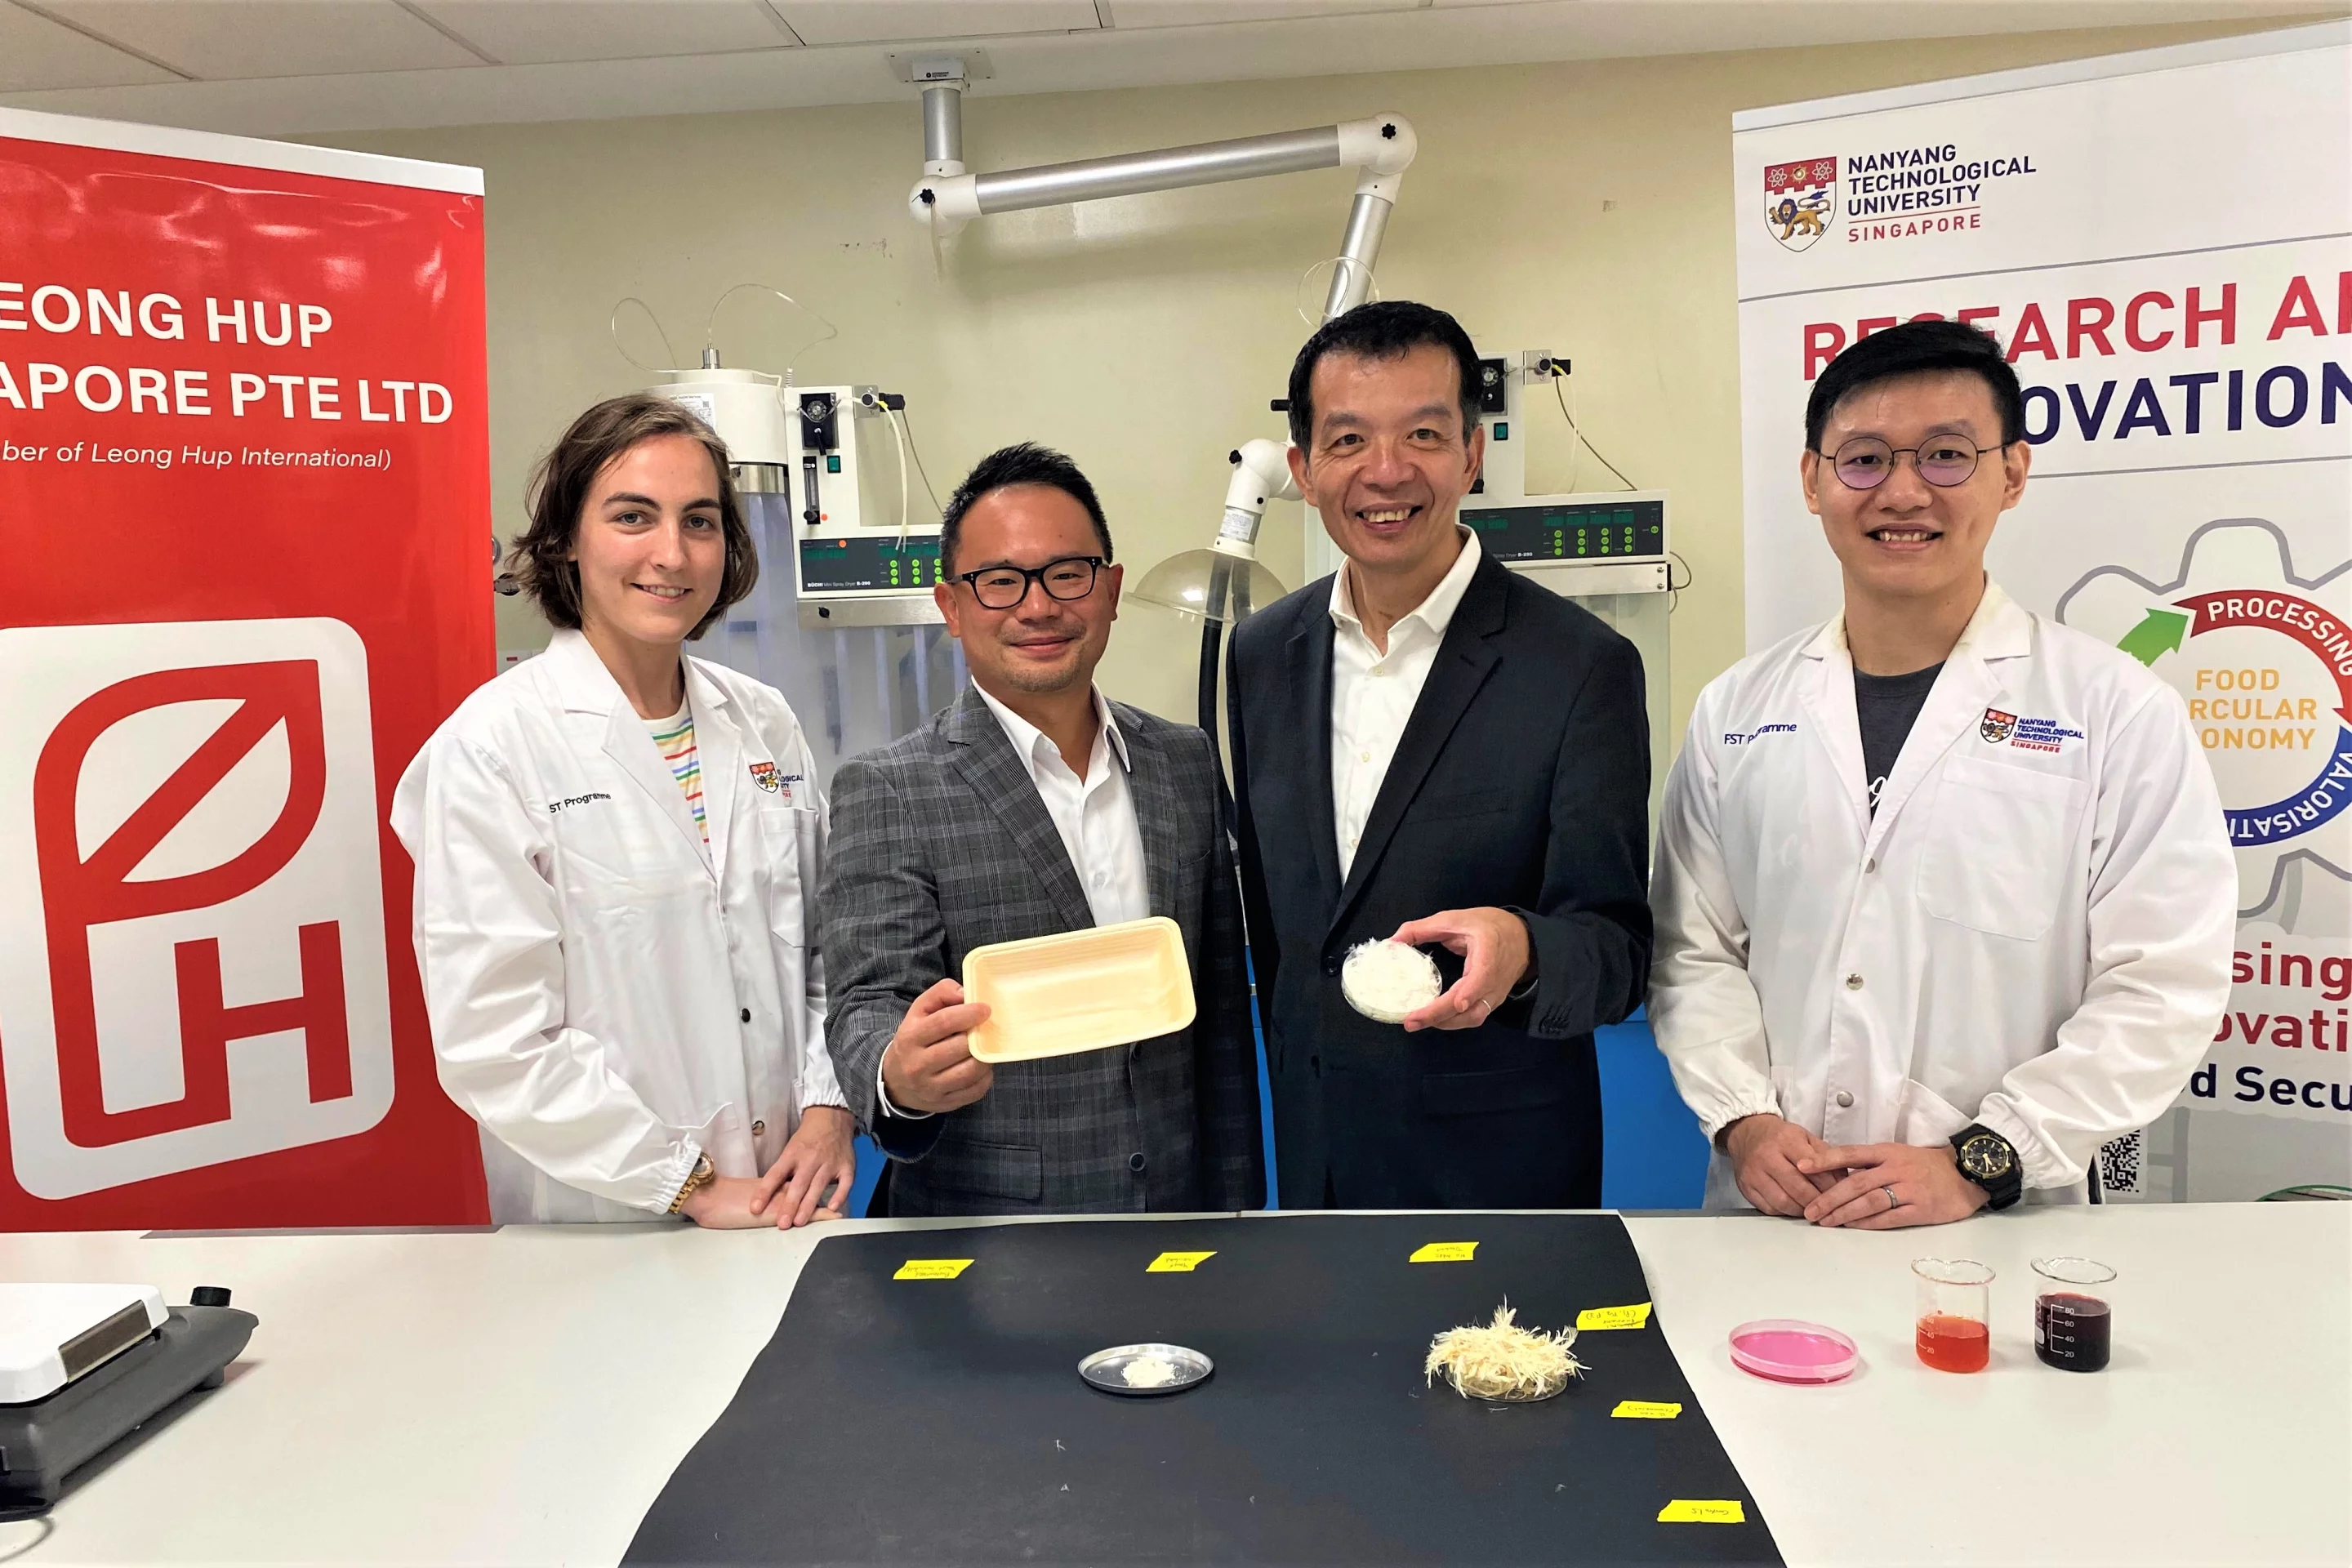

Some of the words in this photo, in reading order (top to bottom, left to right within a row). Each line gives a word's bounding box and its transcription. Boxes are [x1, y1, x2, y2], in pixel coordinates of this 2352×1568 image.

[1848, 144, 1957, 175] NANYANG
[1848, 155, 2037, 195] TECHNOLOGICAL
[1847, 183, 1981, 216] UNIVERSITY
[1847, 213, 1981, 243] SINGAPORE
[0, 281, 185, 341] EONG
[205, 296, 332, 348] HUP
[1803, 282, 2238, 381] RARCH
[229, 372, 342, 421] PTE
[358, 379, 453, 424] LTD
[2, 440, 49, 461] ber
[56, 442, 84, 462] of
[91, 443, 172, 469] Leong
[181, 445, 233, 470] Hup
[241, 446, 392, 471] International)
[2207, 597, 2352, 676] PROCESSING
[2195, 669, 2279, 691] FOOD
[2189, 698, 2317, 720] RCULAR
[2017, 724, 2084, 739] TECHNOLOGICAL
[2018, 718, 2056, 727] NANYANG
[1724, 733, 1745, 745] FST
[2010, 741, 2060, 753] SINGAPORE
[2014, 732, 2063, 743] UNIVERSITY
[2201, 728, 2316, 750] ONOMY
[549, 801, 561, 813] ST
[564, 793, 612, 808] Programme
